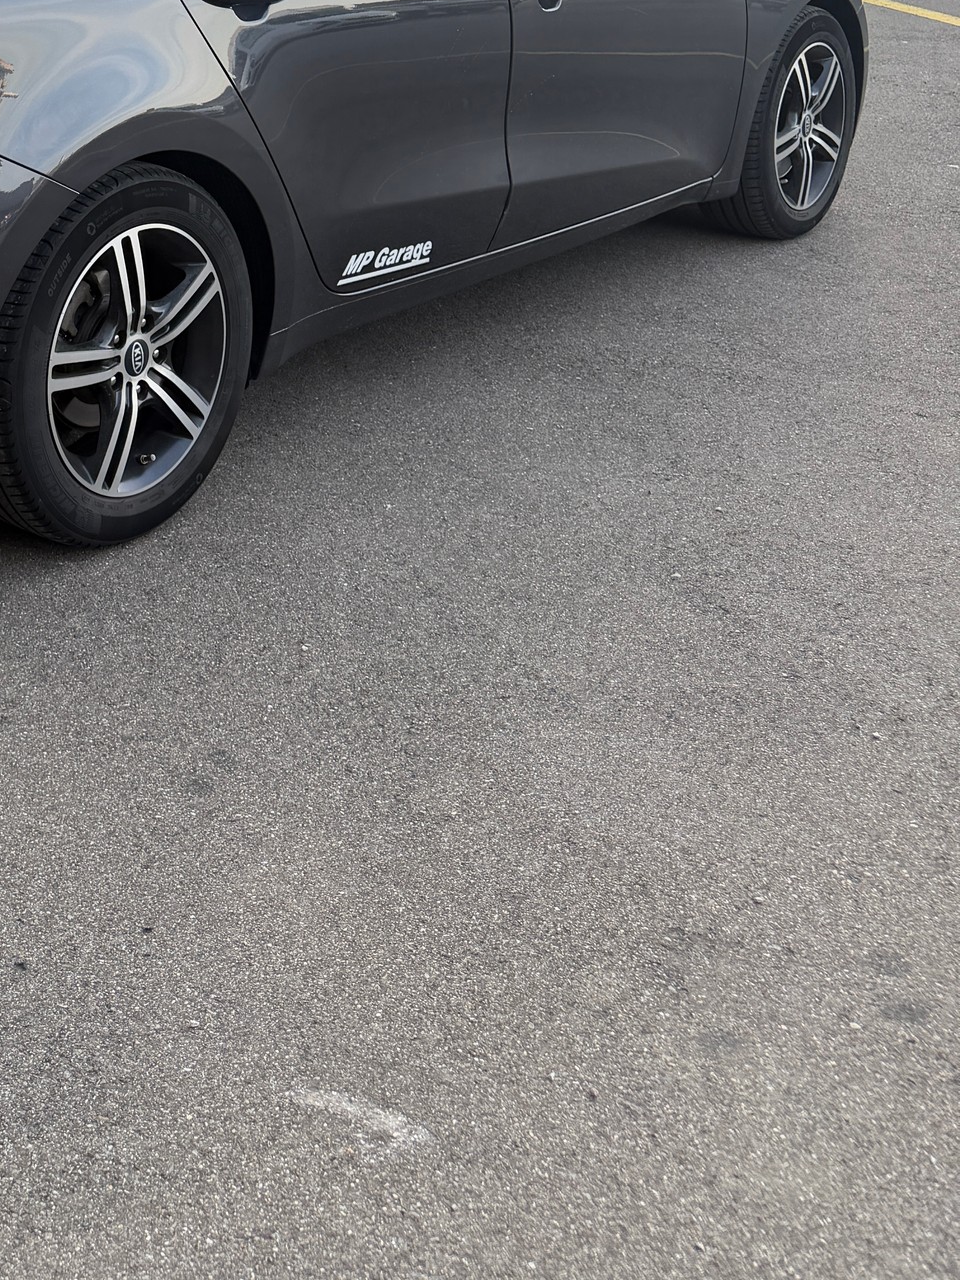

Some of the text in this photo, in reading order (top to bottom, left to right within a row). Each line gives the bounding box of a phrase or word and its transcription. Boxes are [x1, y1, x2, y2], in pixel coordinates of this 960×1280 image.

[47, 252, 72, 297] OUTSIDE
[342, 240, 433, 277] MP Garage
